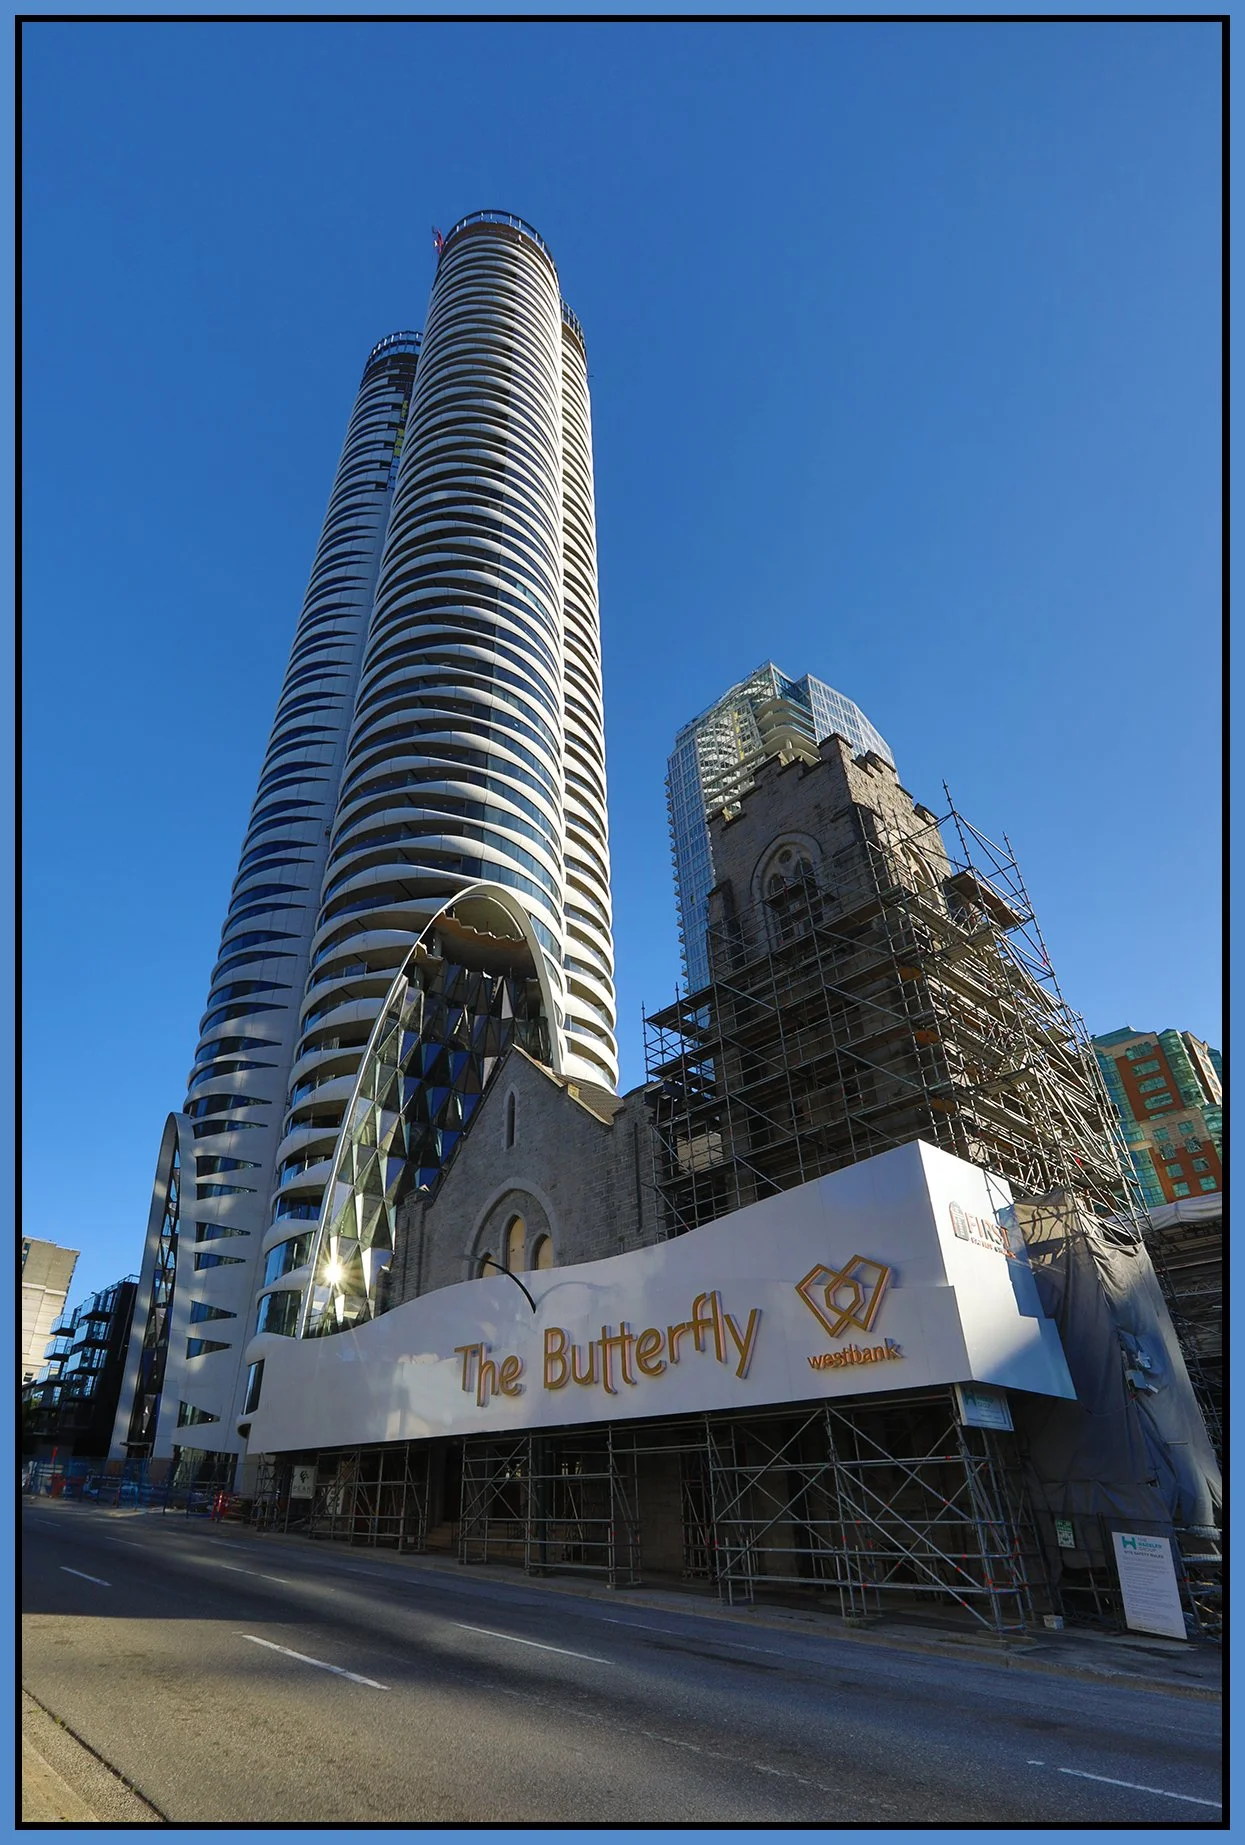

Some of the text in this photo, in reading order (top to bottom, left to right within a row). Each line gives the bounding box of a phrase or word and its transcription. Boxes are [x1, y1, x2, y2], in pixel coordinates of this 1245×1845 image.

[964, 1211, 1011, 1249] FIRST
[454, 1289, 762, 1408] The Butterfly
[807, 1337, 904, 1370] westbank
